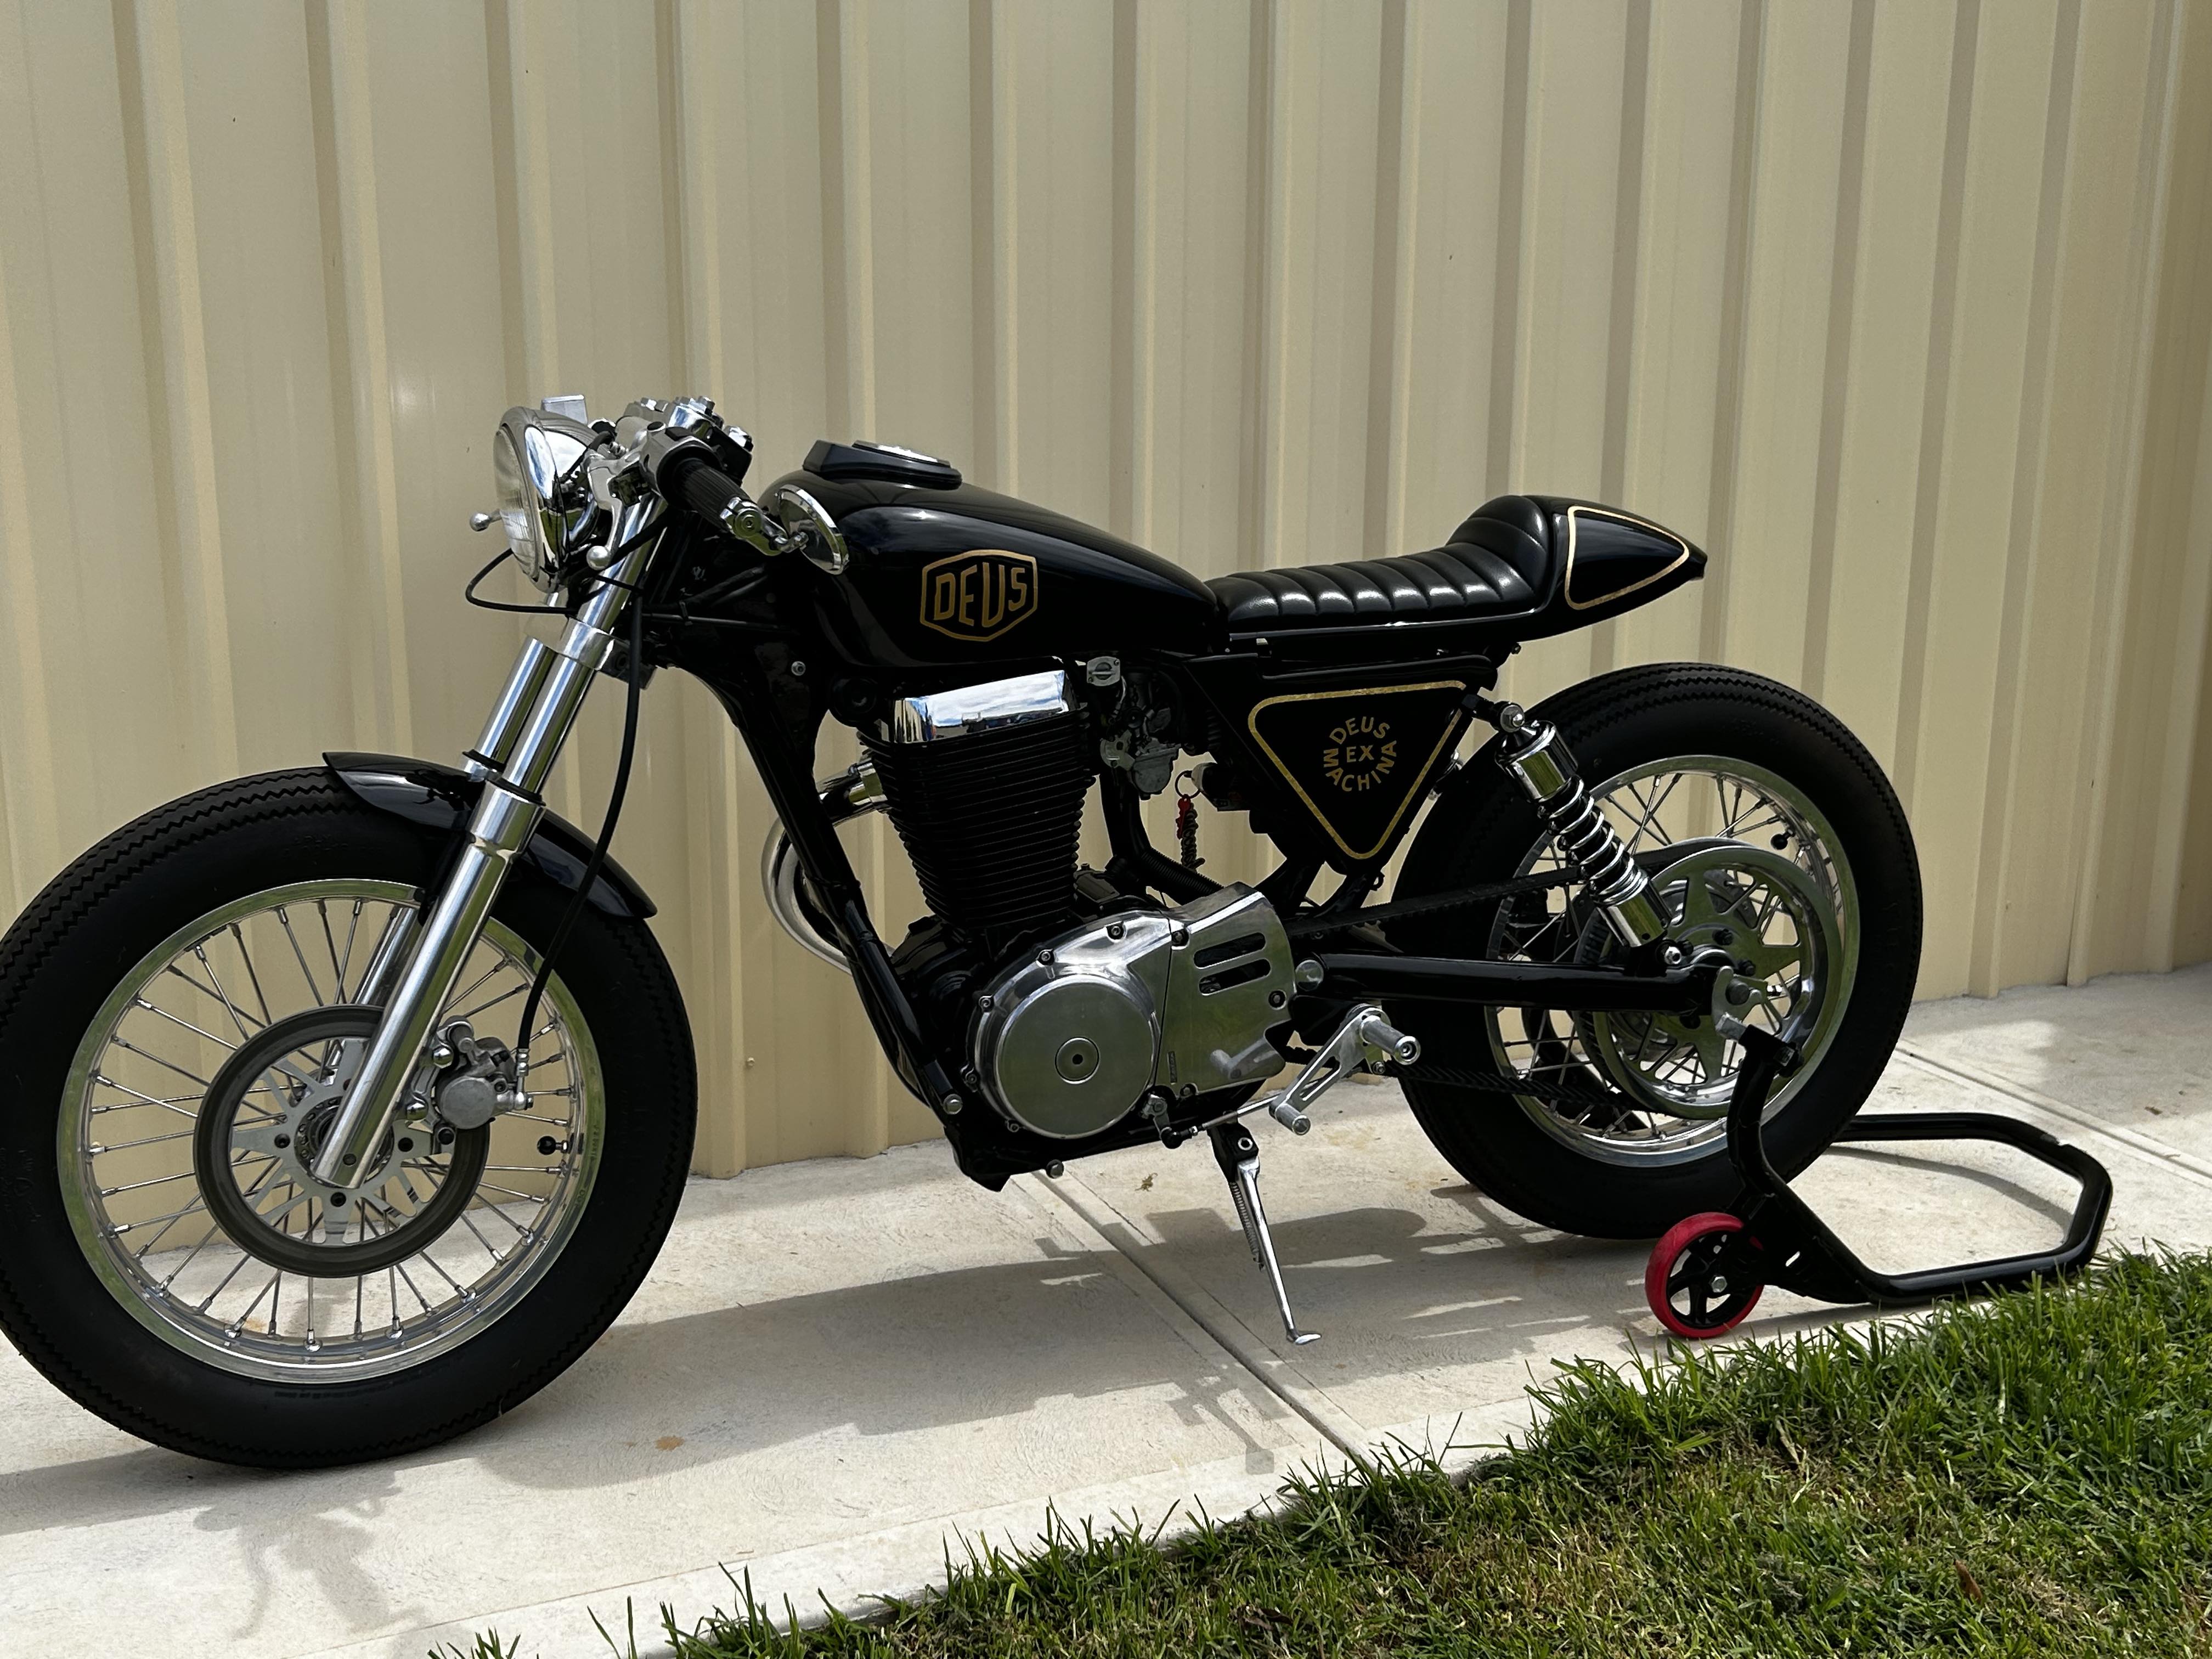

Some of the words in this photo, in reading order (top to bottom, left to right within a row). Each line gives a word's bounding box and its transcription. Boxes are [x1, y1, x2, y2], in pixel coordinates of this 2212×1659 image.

[934, 562, 1027, 628] DEUS
[1329, 716, 1390, 744] DEUS
[1323, 740, 1397, 792] MACHINA
[1346, 744, 1374, 763] EX
